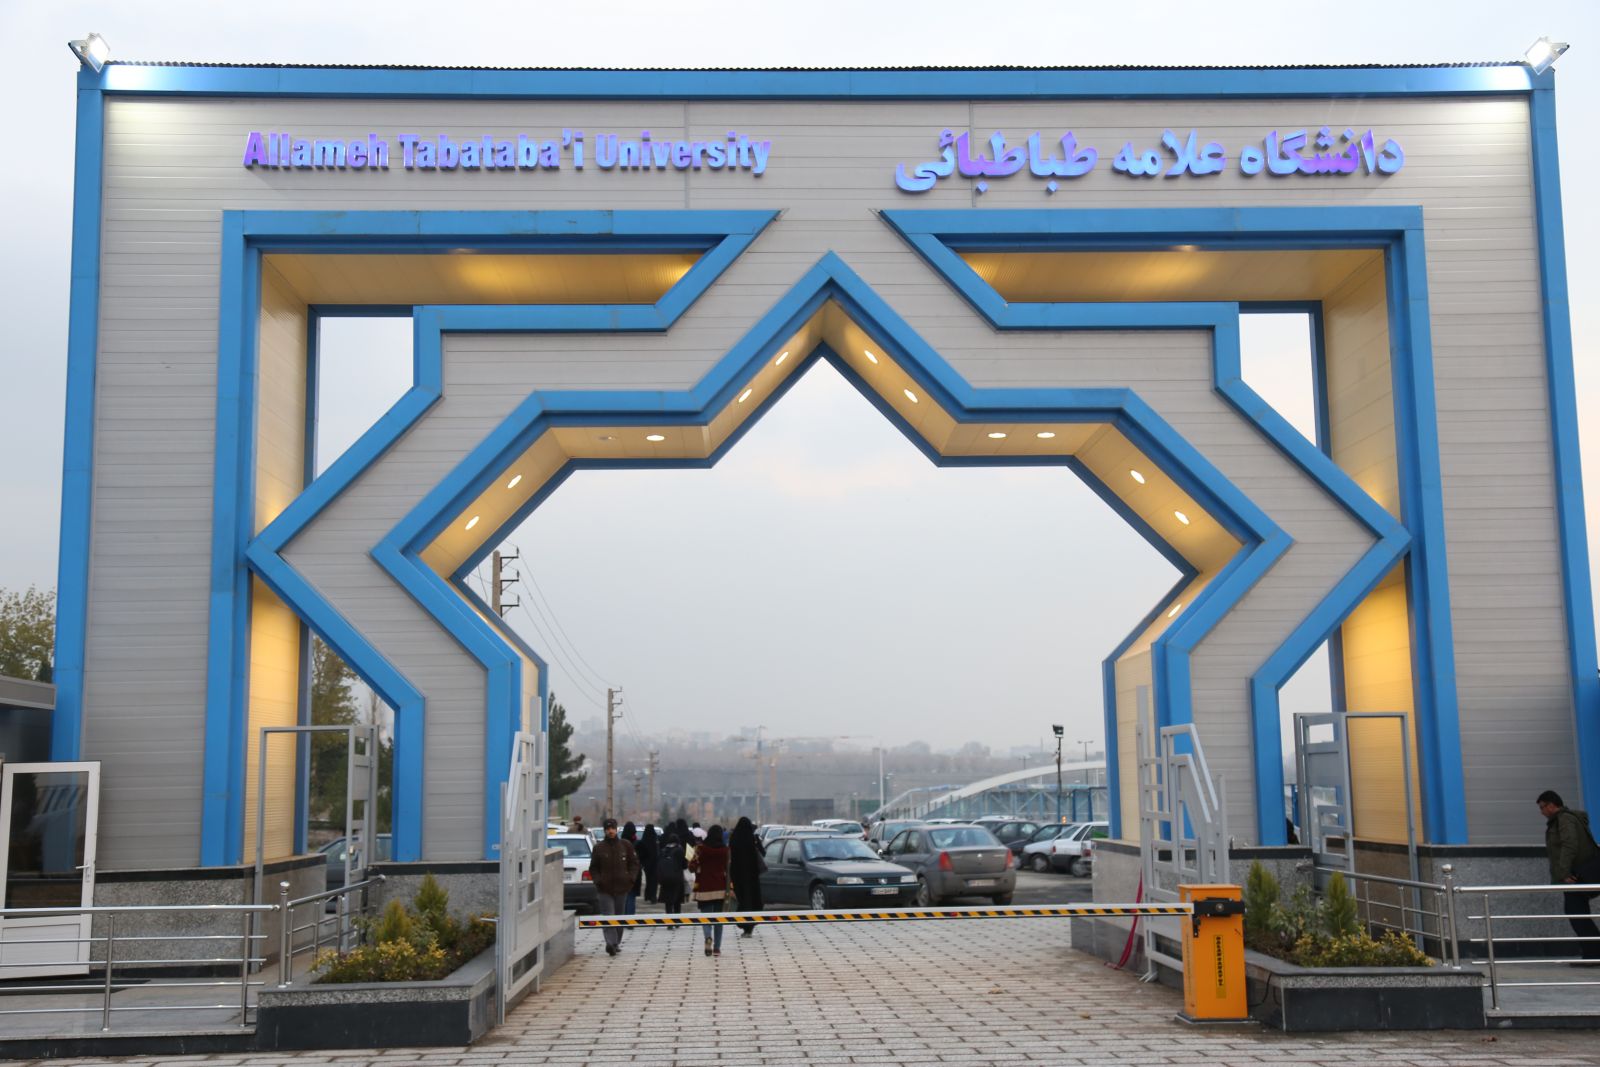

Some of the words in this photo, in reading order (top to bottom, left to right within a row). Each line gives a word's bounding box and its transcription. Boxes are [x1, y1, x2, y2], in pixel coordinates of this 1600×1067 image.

[242, 131, 389, 169] Allameh
[594, 130, 772, 176] University
[1112, 128, 1227, 176] علامه
[1239, 125, 1405, 176] دانشگاه
